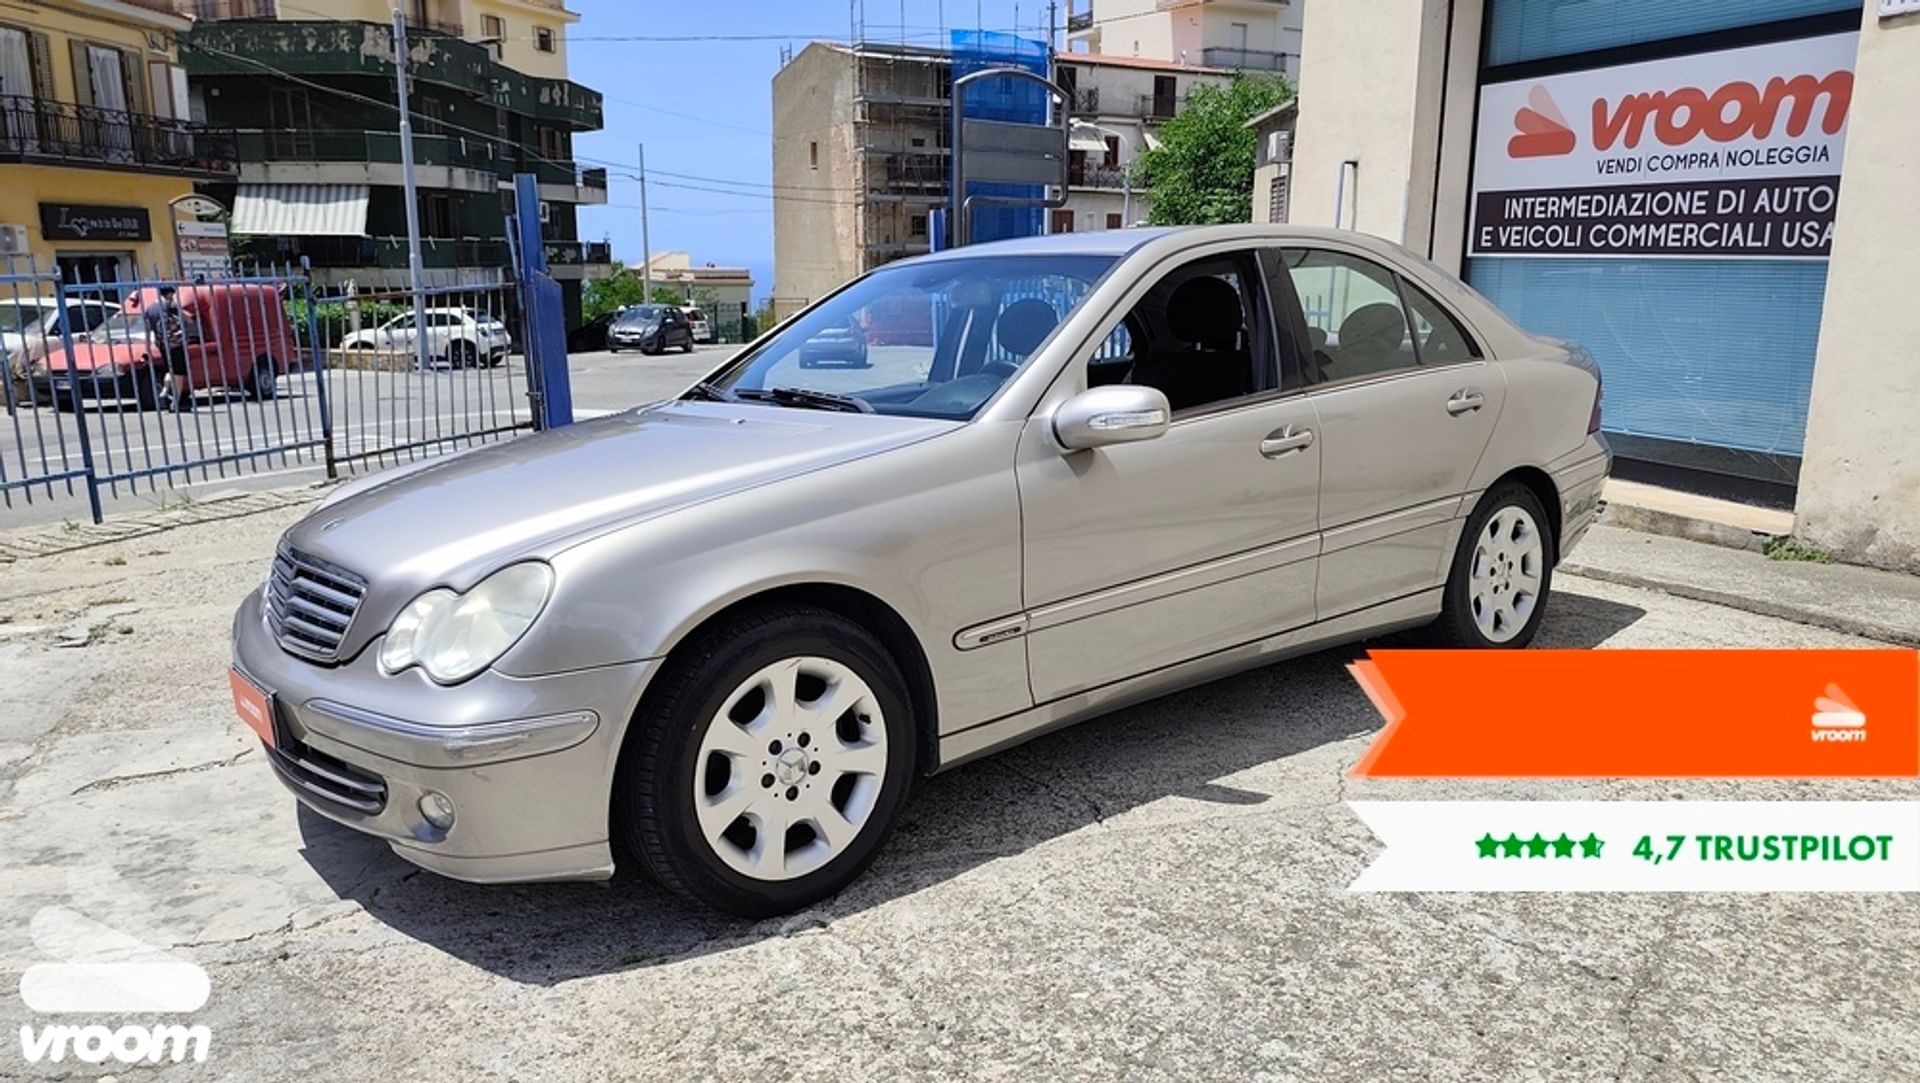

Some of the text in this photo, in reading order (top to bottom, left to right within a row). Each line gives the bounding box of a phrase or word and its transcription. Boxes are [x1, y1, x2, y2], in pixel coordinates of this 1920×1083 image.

[1592, 69, 1855, 151] vroom
[1596, 144, 1830, 175] VENDI COMPRA NOLEGGIA
[1504, 185, 1835, 220] INTERMEDIAZIONE DI AUTO
[1480, 226, 1494, 248] E
[1499, 224, 1583, 248] VEICOLI
[1589, 222, 1772, 248] COMMERCIALI
